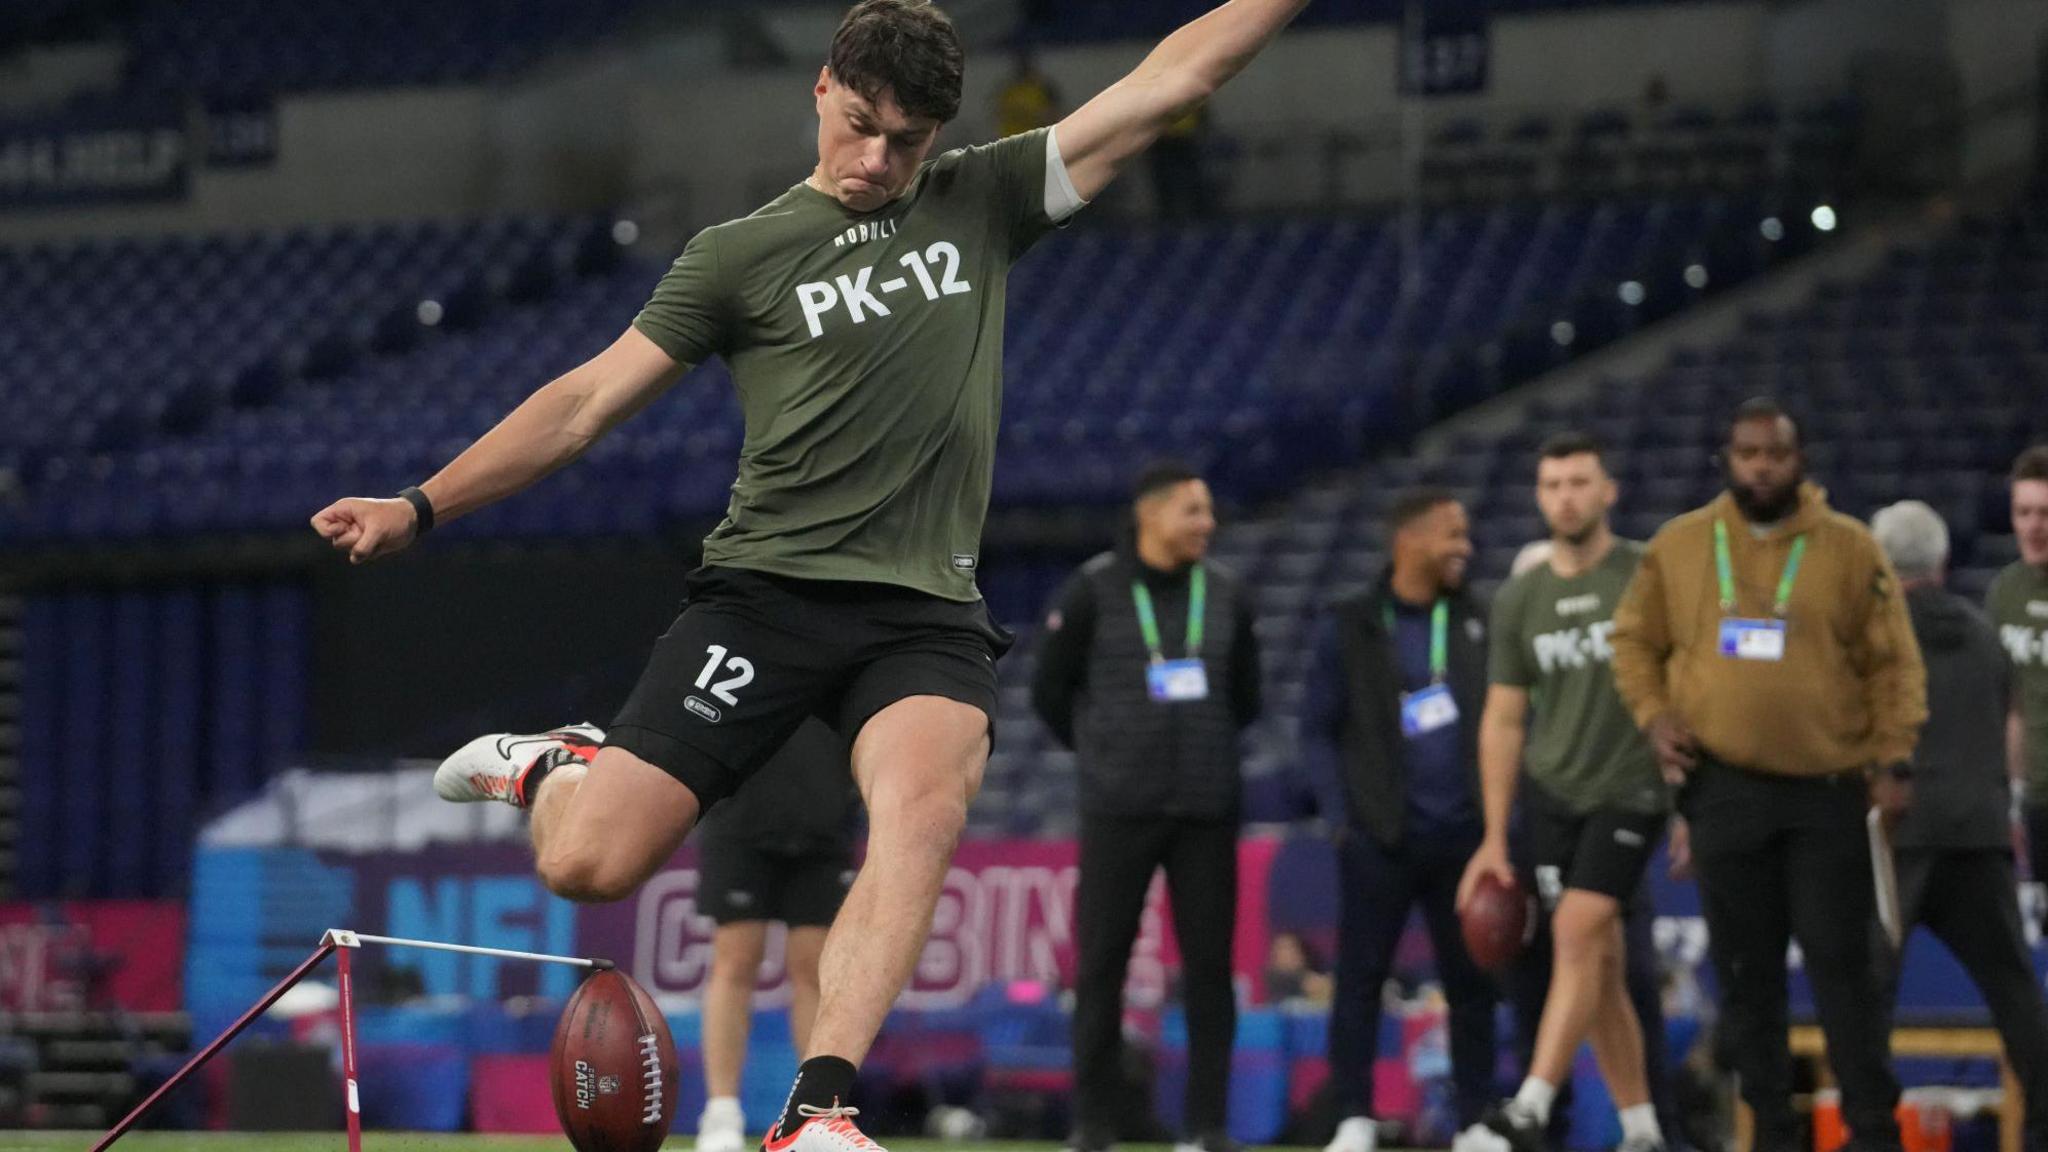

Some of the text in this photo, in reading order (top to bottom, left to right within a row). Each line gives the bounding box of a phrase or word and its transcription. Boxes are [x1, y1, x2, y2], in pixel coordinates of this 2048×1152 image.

[795, 241, 971, 339] PK-12
[694, 644, 755, 707] 12
[575, 1060, 590, 1110] CATCH
[588, 1068, 596, 1103] CRUCIAL
